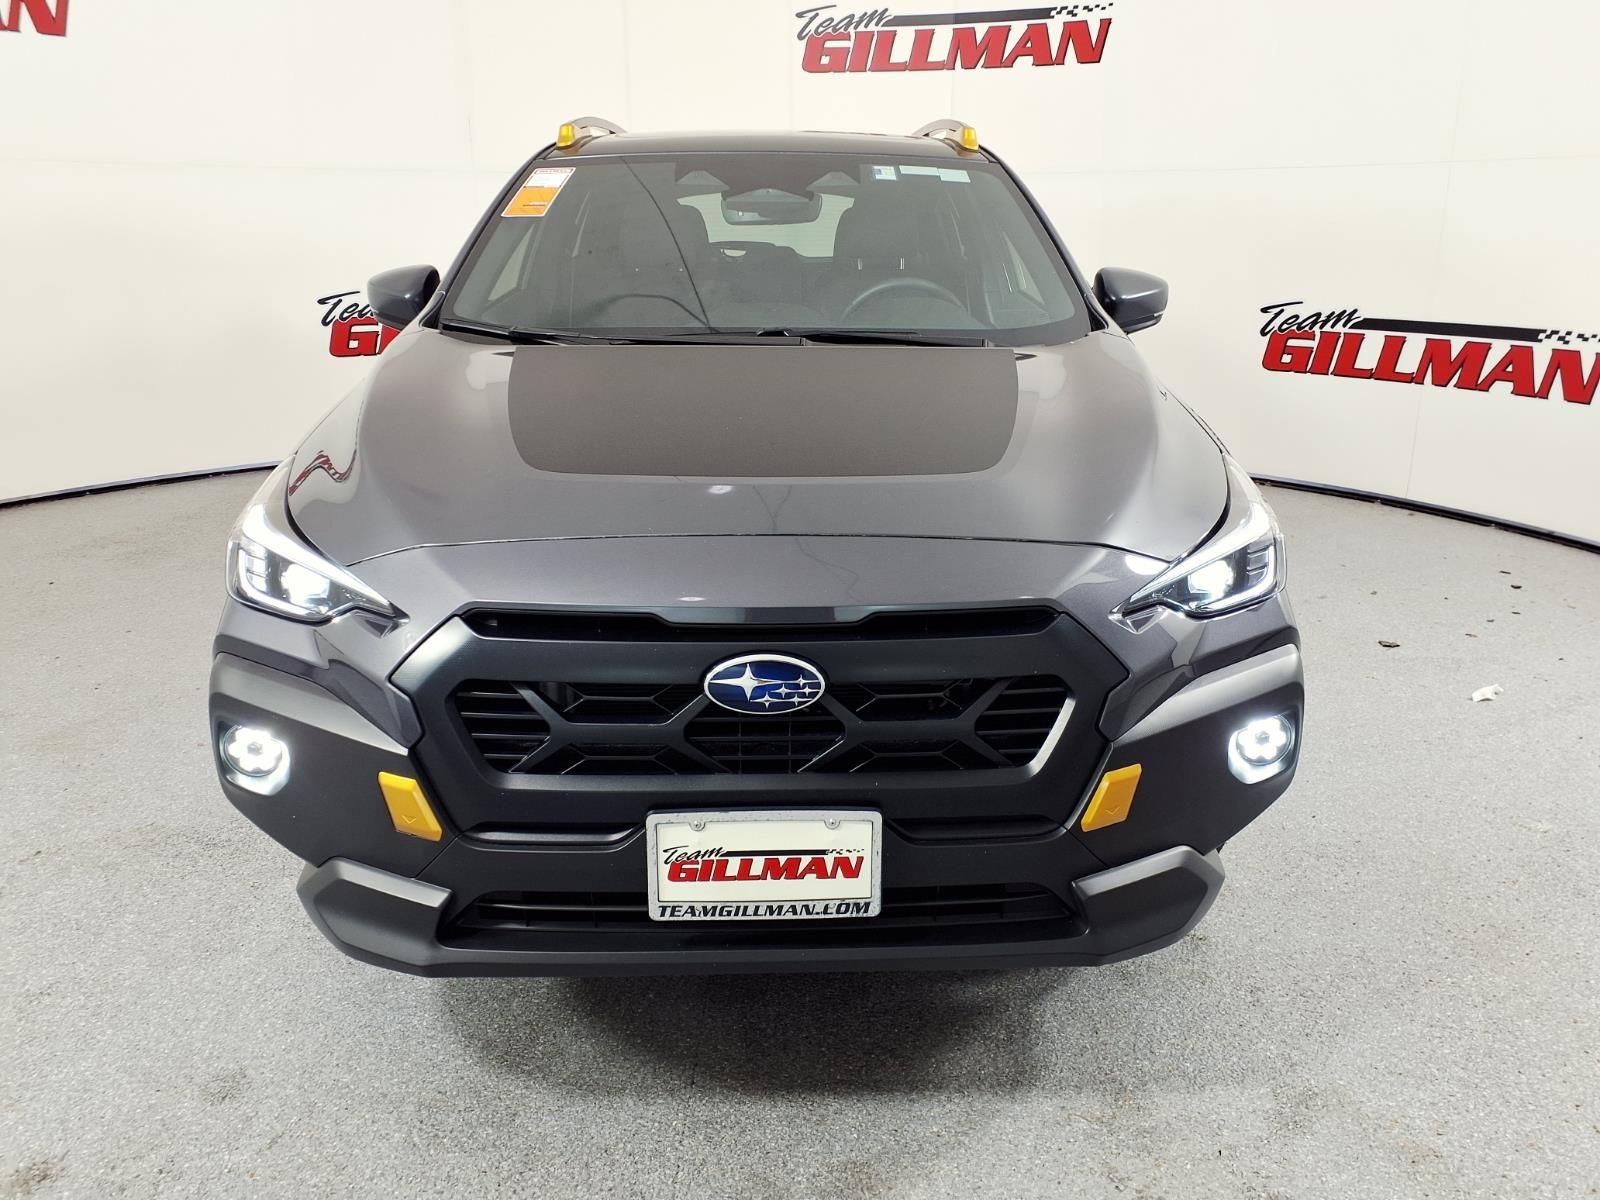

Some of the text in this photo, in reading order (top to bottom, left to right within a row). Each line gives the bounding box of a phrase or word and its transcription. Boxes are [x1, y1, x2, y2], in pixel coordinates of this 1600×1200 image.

[795, 4, 894, 40] Team
[801, 18, 1112, 73] GILLMAN
[1260, 301, 1362, 337] Team
[1262, 329, 1600, 405] GILLMAN
[663, 845, 727, 865] Team
[667, 856, 864, 882] GILLMAN
[658, 901, 872, 918] TEAMGILLMAN.COM
